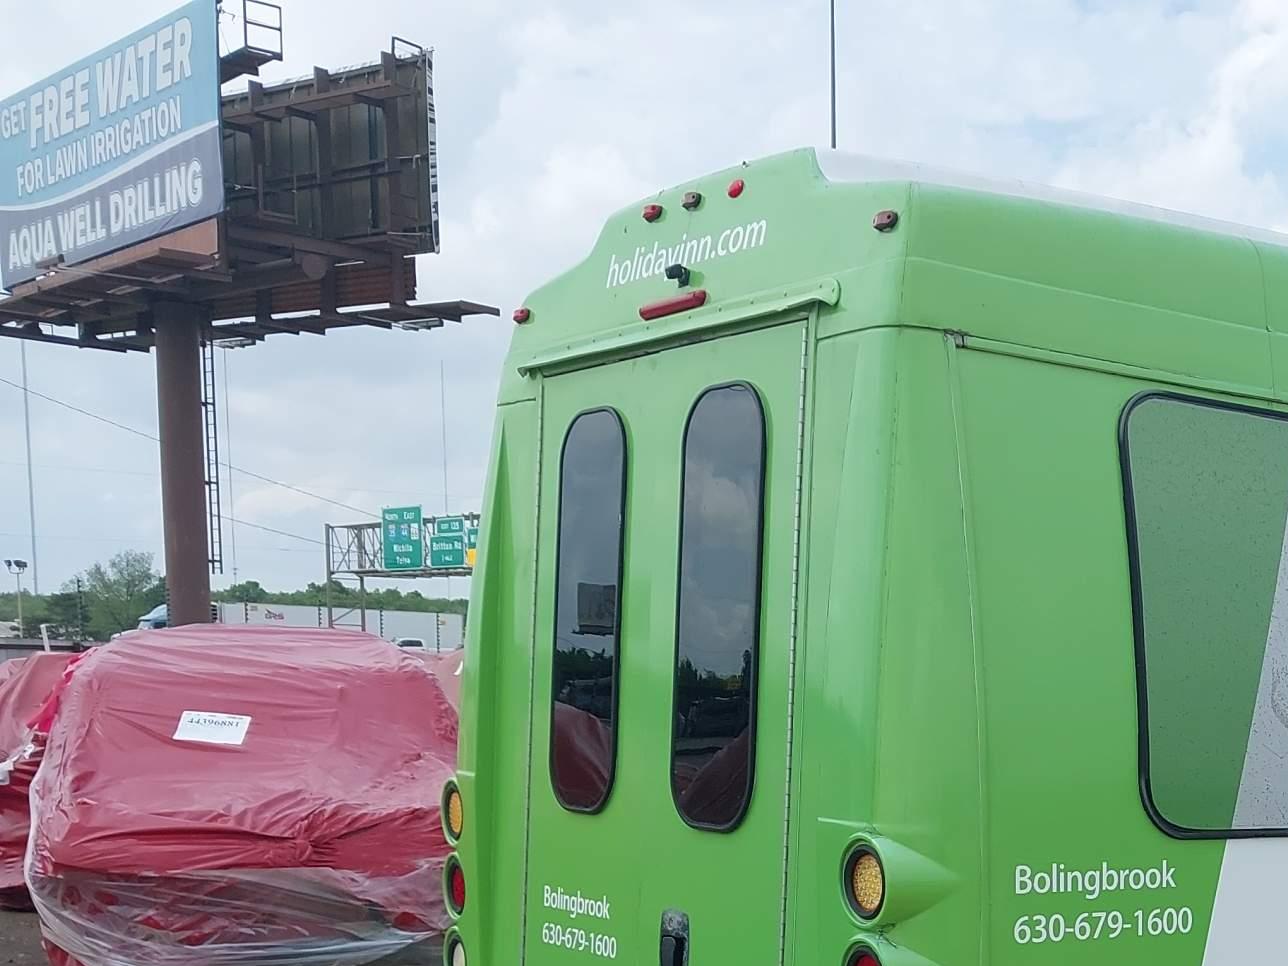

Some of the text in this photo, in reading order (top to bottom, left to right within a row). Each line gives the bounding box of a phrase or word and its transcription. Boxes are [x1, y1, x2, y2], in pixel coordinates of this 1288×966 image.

[1, 17, 192, 149] GET FREE WATER
[17, 96, 181, 197] FOR LAWN IRRIGATION
[9, 158, 203, 270] AQUA WELL DRILLING
[606, 219, 767, 288] holidayinn.com
[543, 885, 610, 920] Bolingbrook
[1015, 859, 1177, 900] Bolingbrook
[542, 922, 617, 959] 630-679-1600
[1013, 906, 1193, 944] 630-679-1600
